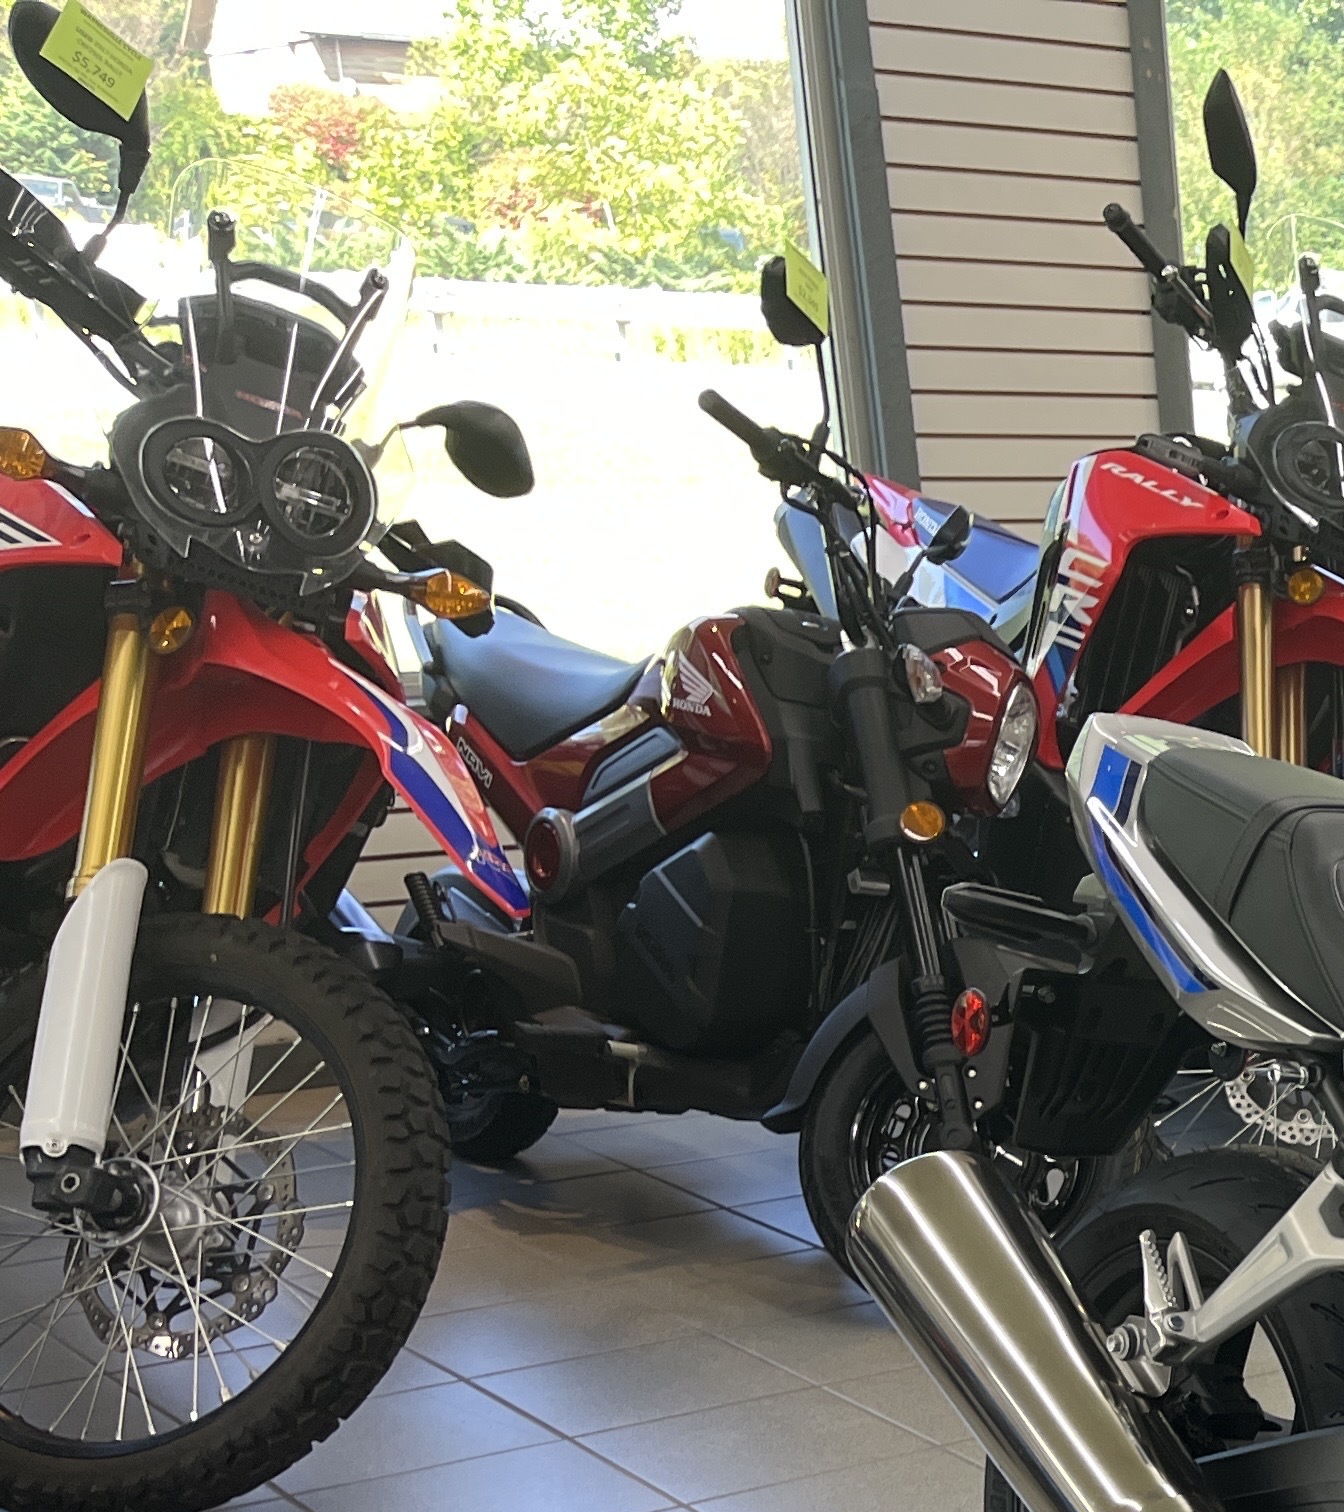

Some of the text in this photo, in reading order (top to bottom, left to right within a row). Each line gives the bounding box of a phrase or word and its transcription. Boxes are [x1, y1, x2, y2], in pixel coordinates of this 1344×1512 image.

[72, 51, 116, 88] $5,749
[1101, 462, 1204, 508] RALLY
[672, 699, 711, 717] HONDA
[457, 738, 493, 789] NAVI
